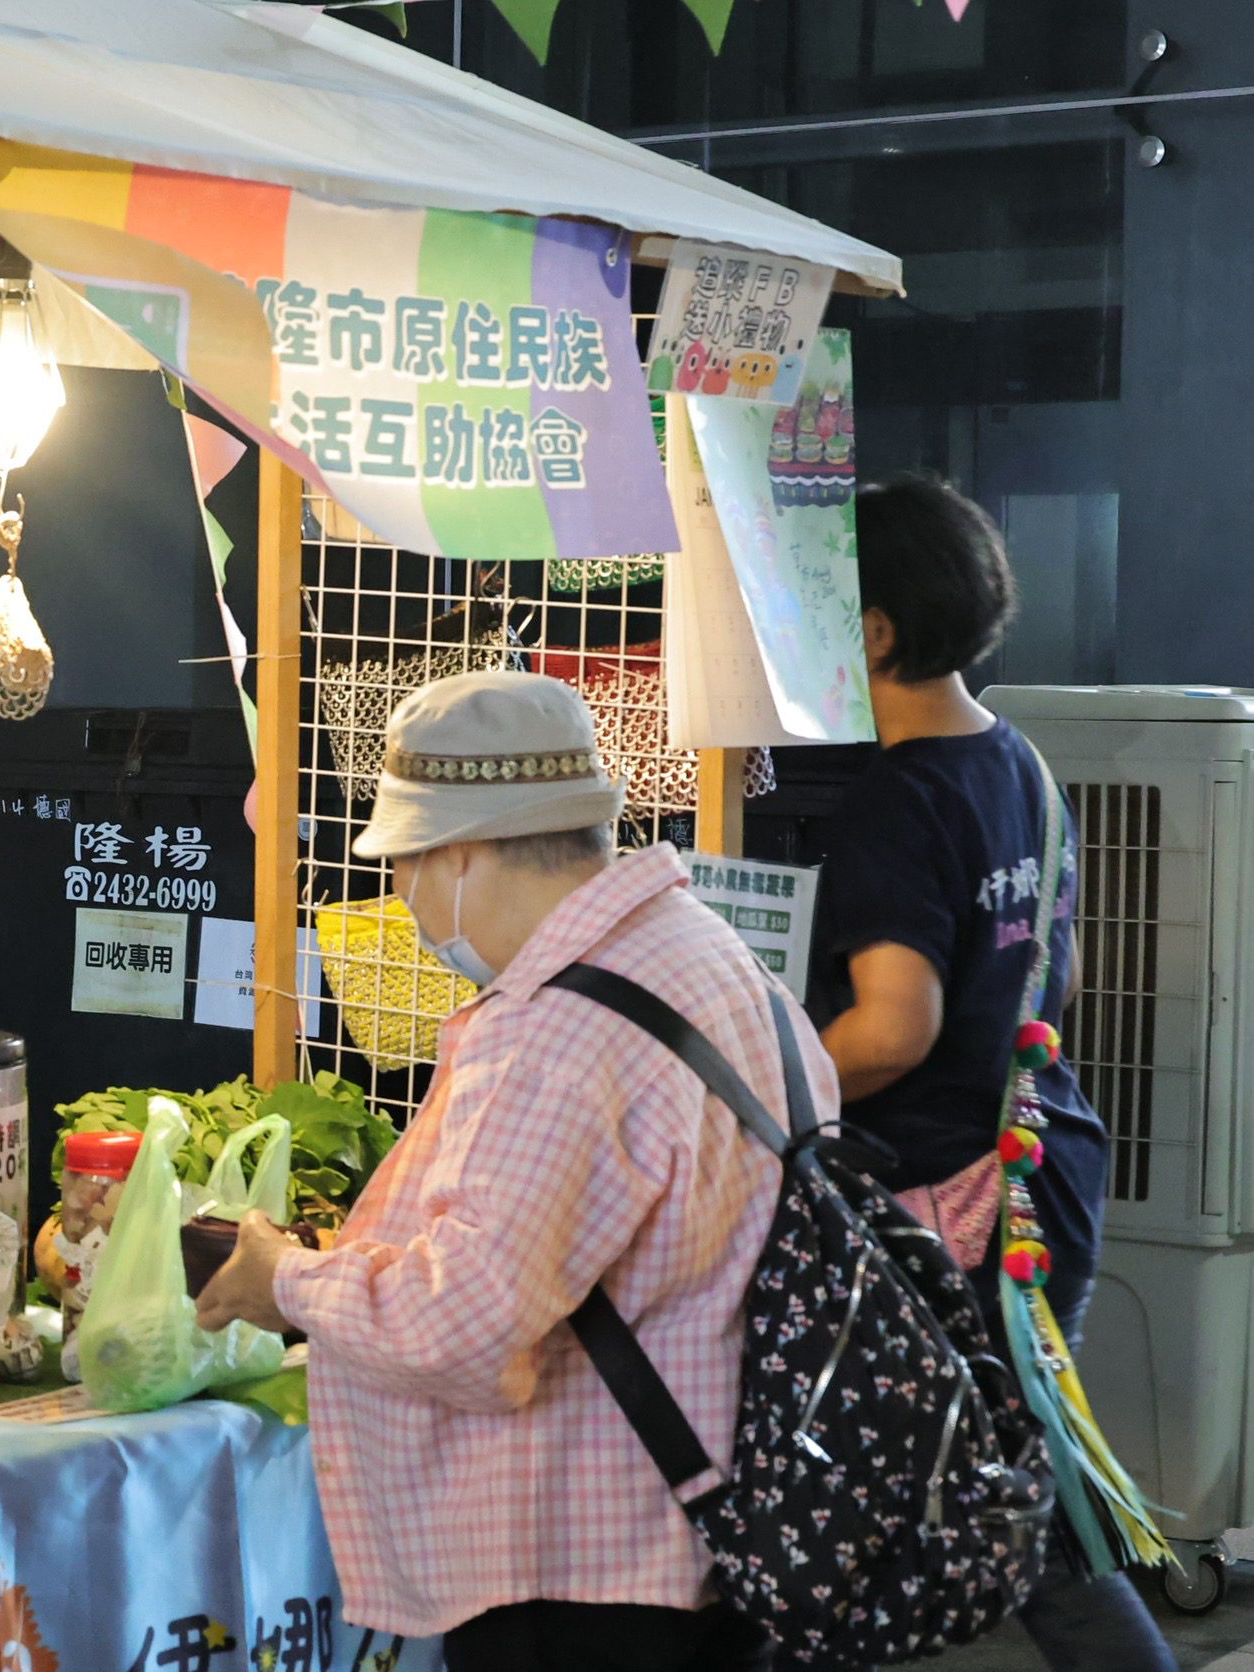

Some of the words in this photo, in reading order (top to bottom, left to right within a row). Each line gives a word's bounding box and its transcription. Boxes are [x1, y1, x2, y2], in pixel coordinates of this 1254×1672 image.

[222, 272, 610, 390] 隆市原住民族
[269, 388, 588, 490] 活互助協會
[93, 871, 217, 913] 2432-6999
[85, 942, 173, 974] 回收專用
